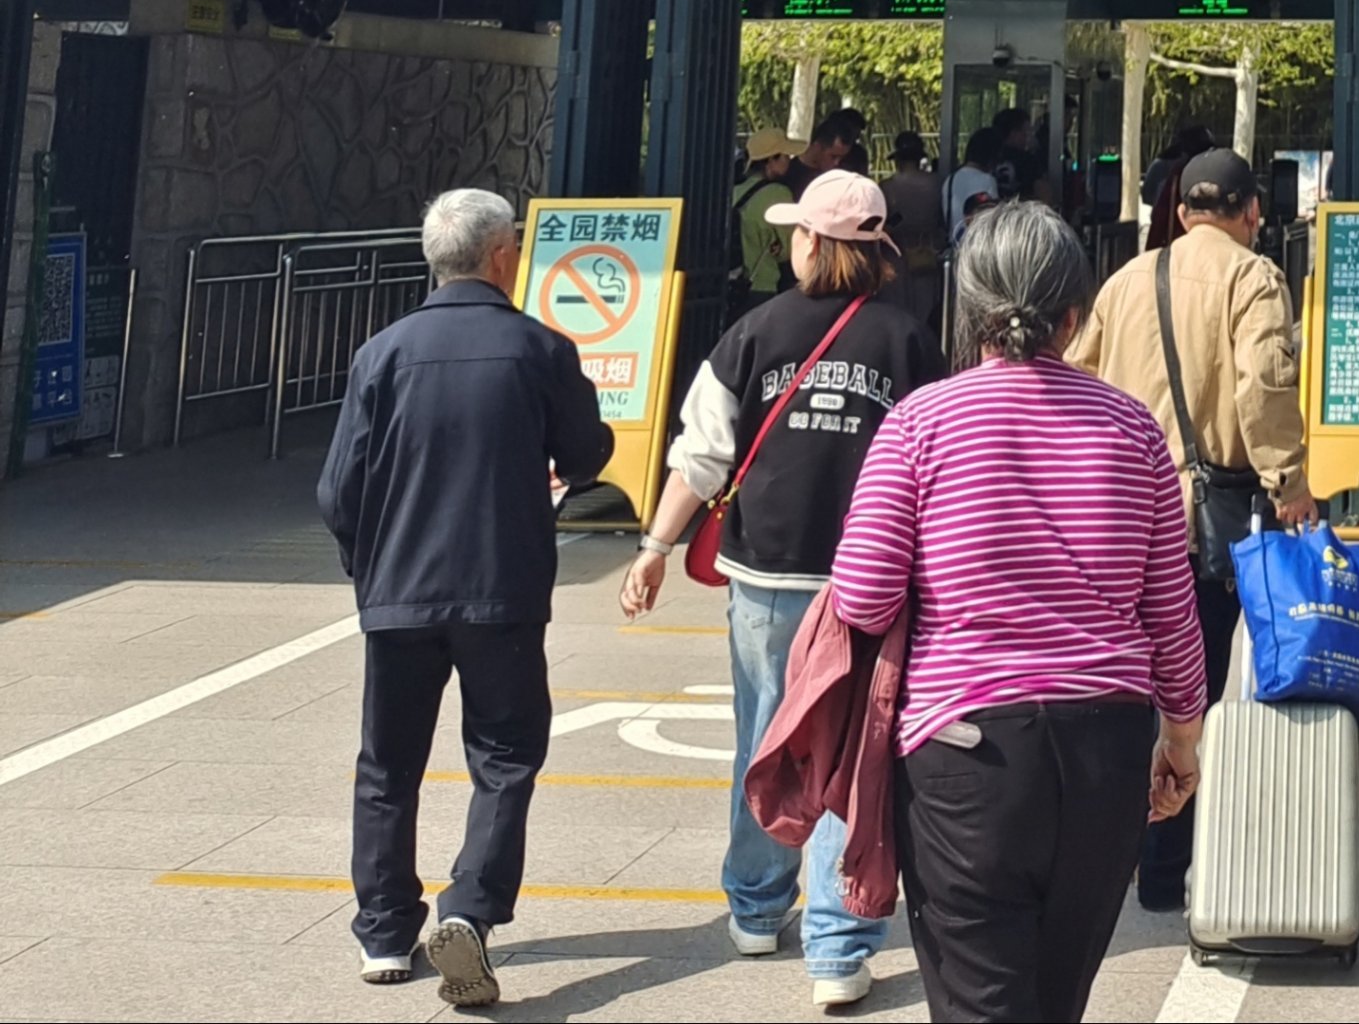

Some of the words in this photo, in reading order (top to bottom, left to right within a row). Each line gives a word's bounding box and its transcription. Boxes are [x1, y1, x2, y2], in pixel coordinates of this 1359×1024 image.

[538, 214, 661, 242] 全园禁烟
[761, 361, 895, 410] BASEBALL
[811, 412, 841, 432] FOR
[843, 416, 861, 434] IT
